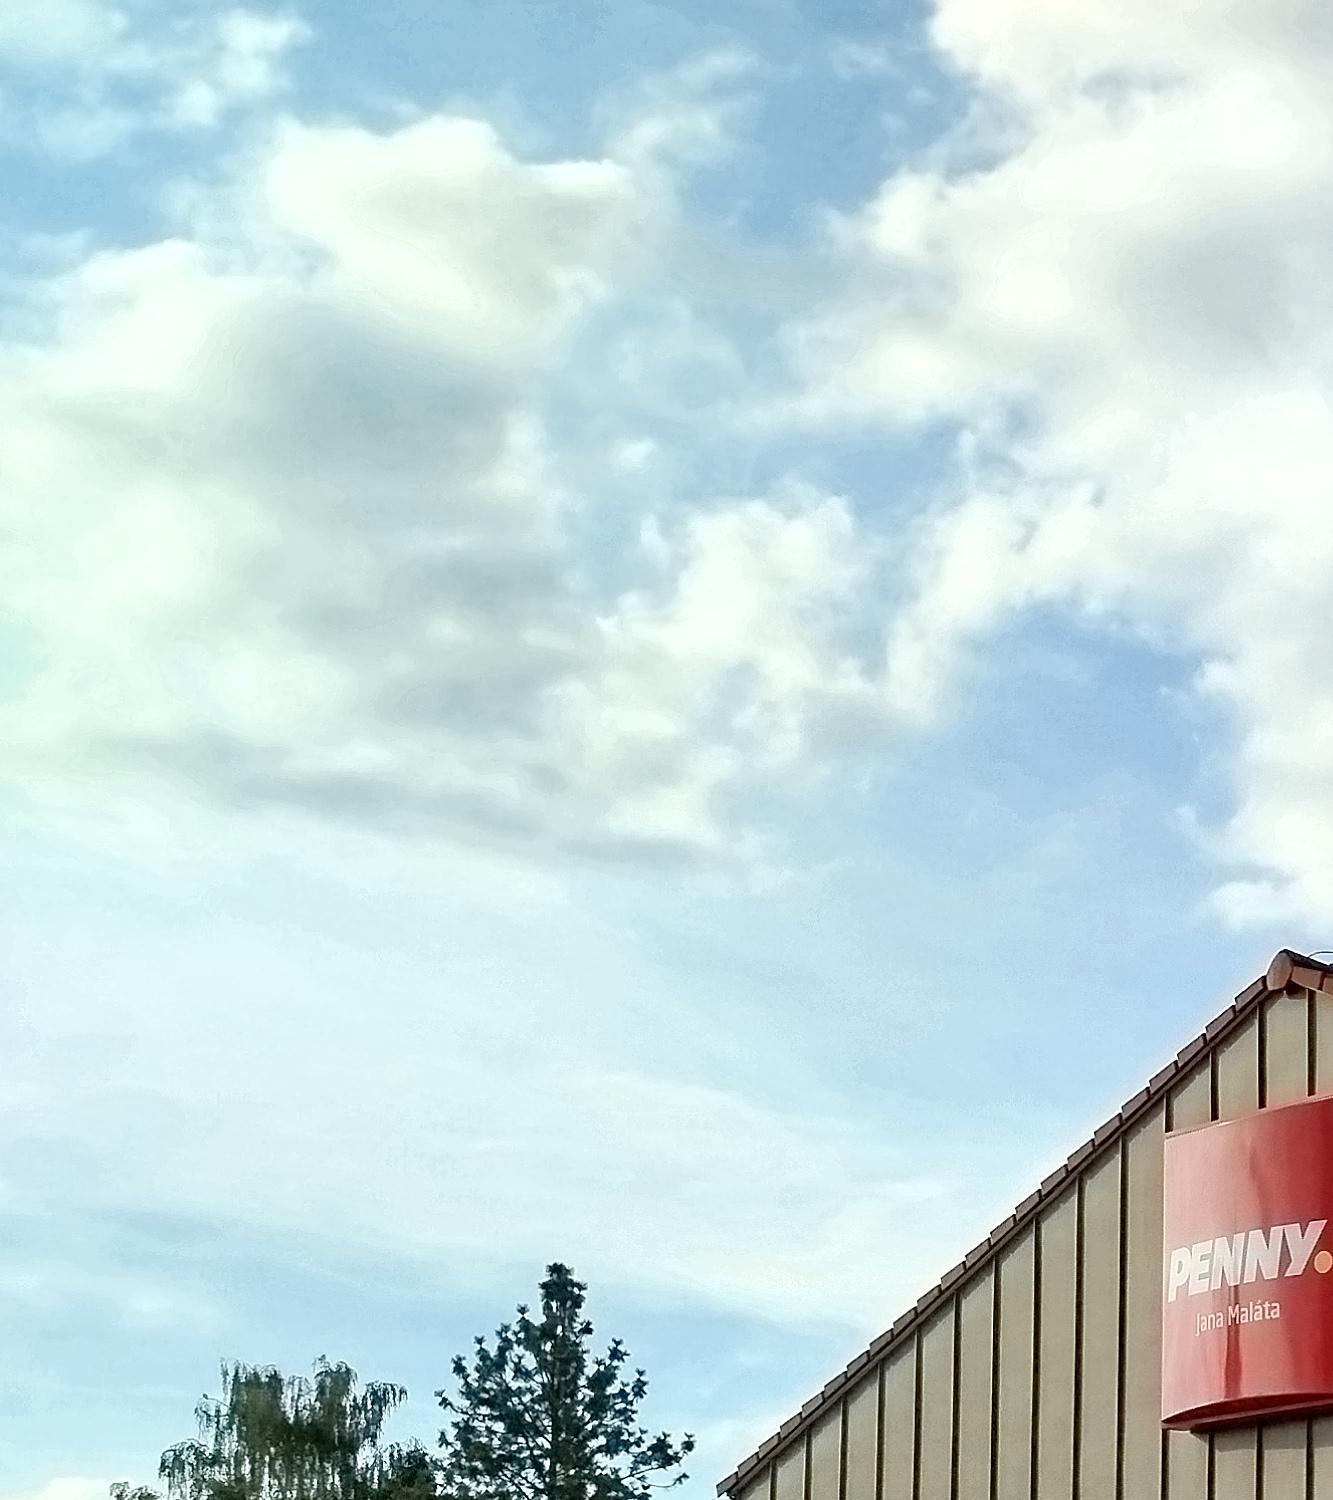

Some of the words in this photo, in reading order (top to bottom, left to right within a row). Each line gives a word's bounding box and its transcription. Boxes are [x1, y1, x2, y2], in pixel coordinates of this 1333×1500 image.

[1168, 1219, 1333, 1303] PENNY.
[1195, 1311, 1225, 1336] Jana
[1228, 1299, 1281, 1327] Maláta
